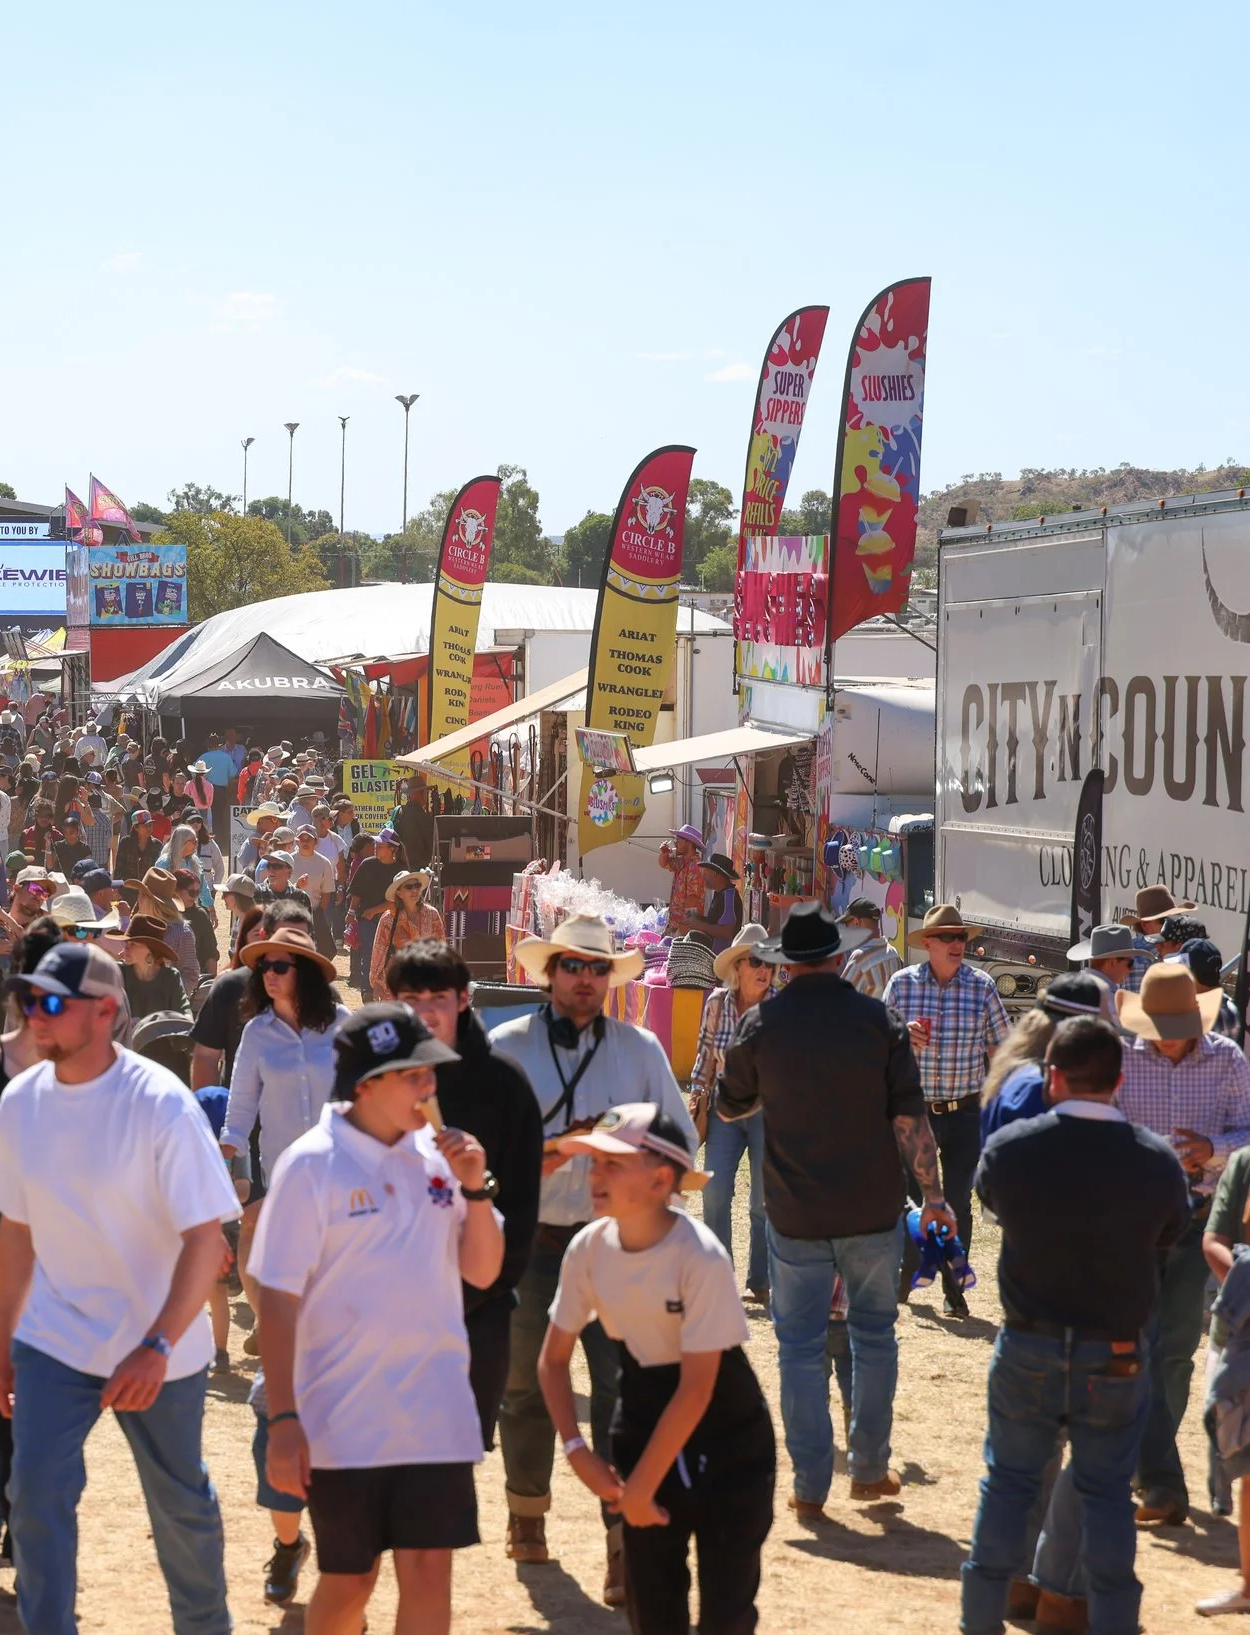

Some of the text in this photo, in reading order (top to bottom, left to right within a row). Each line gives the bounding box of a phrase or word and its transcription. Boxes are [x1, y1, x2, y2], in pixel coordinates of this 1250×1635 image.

[773, 370, 805, 398] SUPER
[861, 374, 916, 401] SLUSHIES
[764, 398, 806, 426] SIPPERS
[744, 502, 776, 527] REFILLS
[0, 526, 10, 535] TO
[12, 526, 26, 535] YOU
[28, 526, 39, 535] BY
[622, 530, 676, 554] CIRCLE B
[448, 545, 486, 565] CIRCLE B
[621, 543, 675, 561] WESTERN WEAR
[628, 553, 665, 566] SADDLERY
[90, 562, 187, 579] SHOWBAGS
[618, 628, 657, 643] ARIAT
[609, 649, 663, 664] THOMAS
[617, 663, 652, 677] COOK
[217, 676, 330, 691] AKUBRA
[608, 705, 652, 719] RODEO
[613, 719, 645, 732] KING
[960, 680, 1058, 813] CITY
[1057, 693, 1082, 782] N
[351, 764, 377, 780] GEL
[847, 752, 876, 784] Nose Cone
[351, 780, 398, 794] BLASTE
[1137, 848, 1150, 889] &
[1156, 848, 1248, 914] APPAREL
